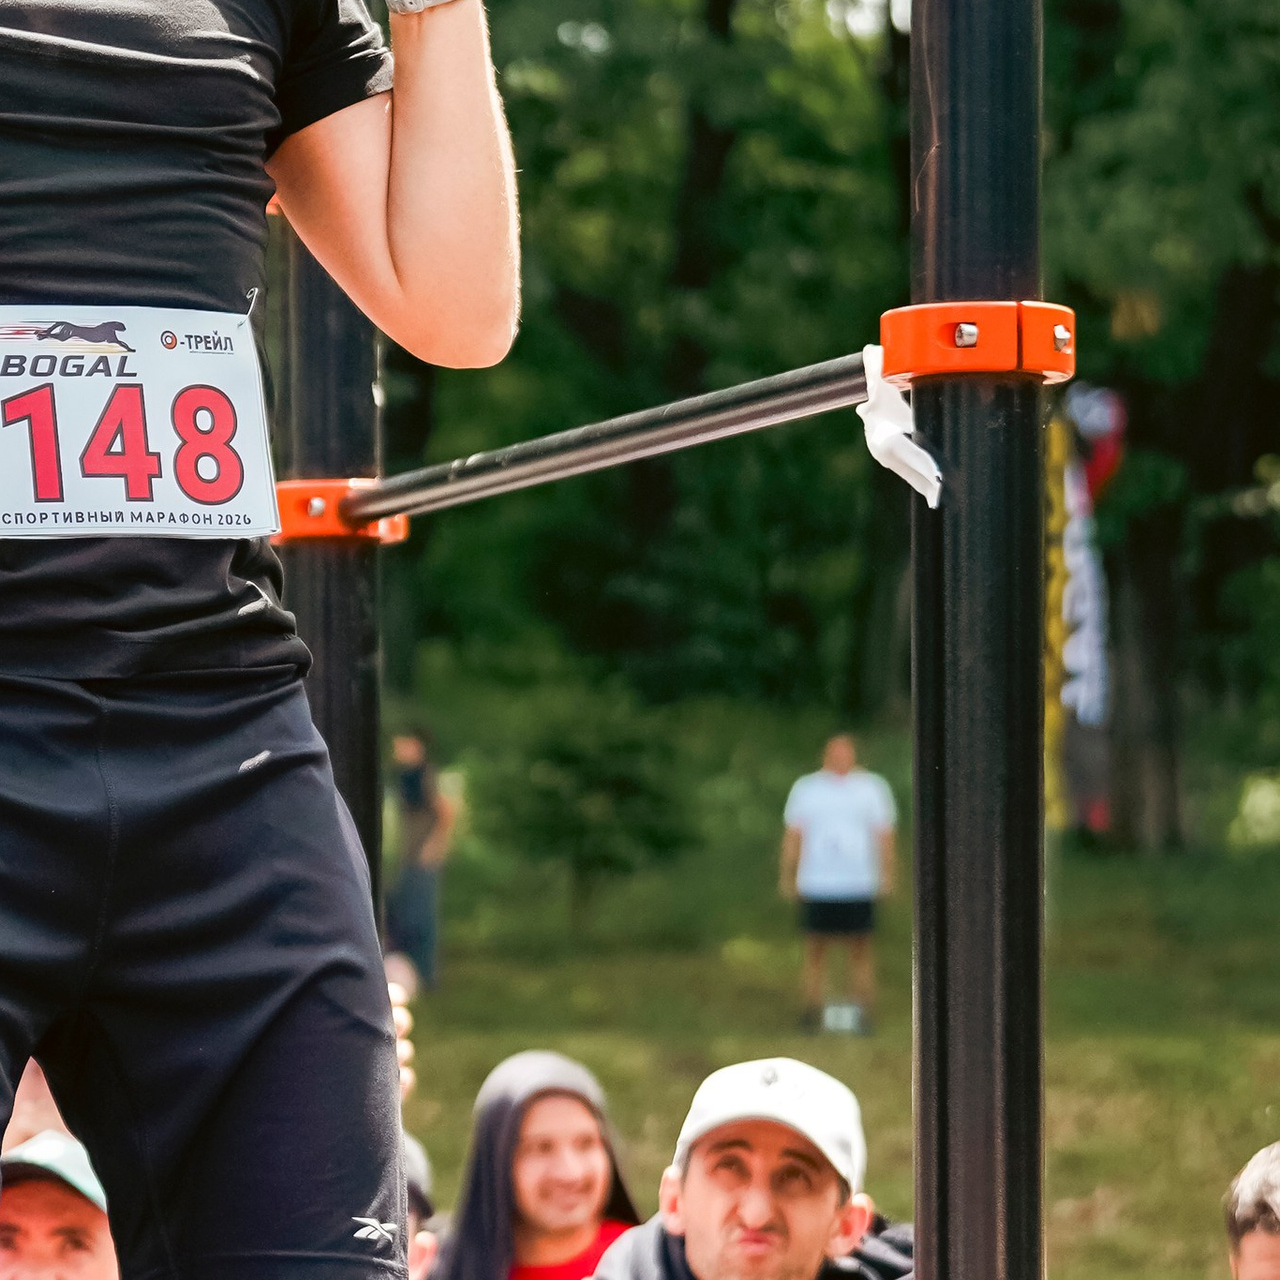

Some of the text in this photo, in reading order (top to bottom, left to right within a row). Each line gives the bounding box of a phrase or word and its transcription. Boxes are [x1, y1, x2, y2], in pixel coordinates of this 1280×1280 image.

[0, 354, 137, 377] BOGAL
[0, 382, 245, 505] 148
[1, 511, 252, 526] СПОРТИВНЫЙ МАРАФОН 2026
